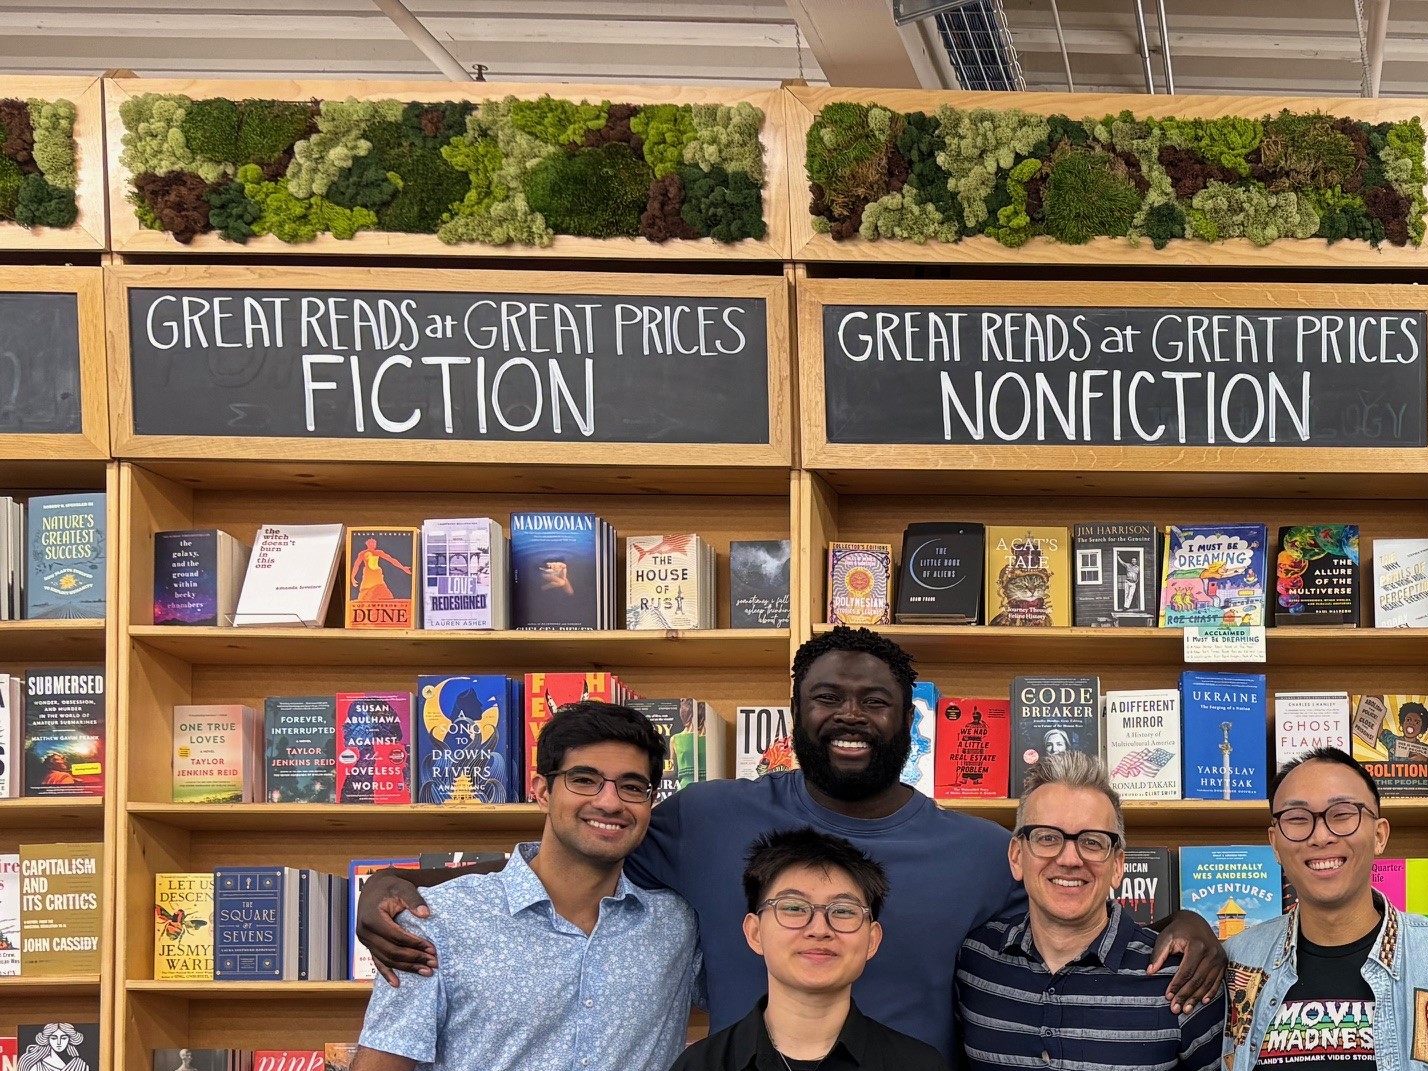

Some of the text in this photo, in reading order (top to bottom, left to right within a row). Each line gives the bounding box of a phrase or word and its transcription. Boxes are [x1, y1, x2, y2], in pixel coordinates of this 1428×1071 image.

[146, 295, 746, 356] GREAT READS at GREAT PRICES
[838, 312, 1418, 364] GREAT READS at GREAT PRICES
[302, 355, 593, 436] FICTION
[941, 370, 1311, 443] NONFICTION
[42, 514, 94, 529] NATURE'S
[513, 515, 592, 530] MADWOMAN
[1077, 523, 1149, 535] JIM HARRISON
[42, 530, 94, 545] GREATEST
[45, 545, 90, 559] SUCCESS
[1188, 542, 1238, 553] I MUST BE
[652, 556, 672, 565] THE
[1179, 553, 1246, 568] DREAMING
[636, 569, 688, 582] HOUSE
[448, 578, 473, 594] LOVE
[655, 585, 669, 594] OF
[432, 595, 487, 611] REDESIGNED
[353, 609, 407, 623] DUNE
[28, 676, 103, 695] SUBMERSED
[1021, 688, 1093, 704] CODE
[1193, 690, 1258, 703] UKRAINE
[1022, 706, 1093, 717] BREAKER
[1110, 699, 1175, 713] A DIFFERENT
[180, 723, 236, 732] ONE TRUE
[1123, 716, 1163, 728] MIRROR
[190, 735, 225, 744] LOVES
[348, 737, 397, 745] AGAINST
[345, 767, 400, 775] LOVELESS
[352, 782, 394, 790] WORLD
[23, 858, 95, 876] CAPITALISM
[1197, 863, 1262, 871] ACCIDENTALLY
[23, 877, 47, 893] AND
[1191, 883, 1273, 902] ADVENTURES
[23, 893, 97, 911] ITS CRITICS
[23, 936, 98, 952] JOHN CASSIDY
[1285, 1055, 1325, 1063] LANDMARK
